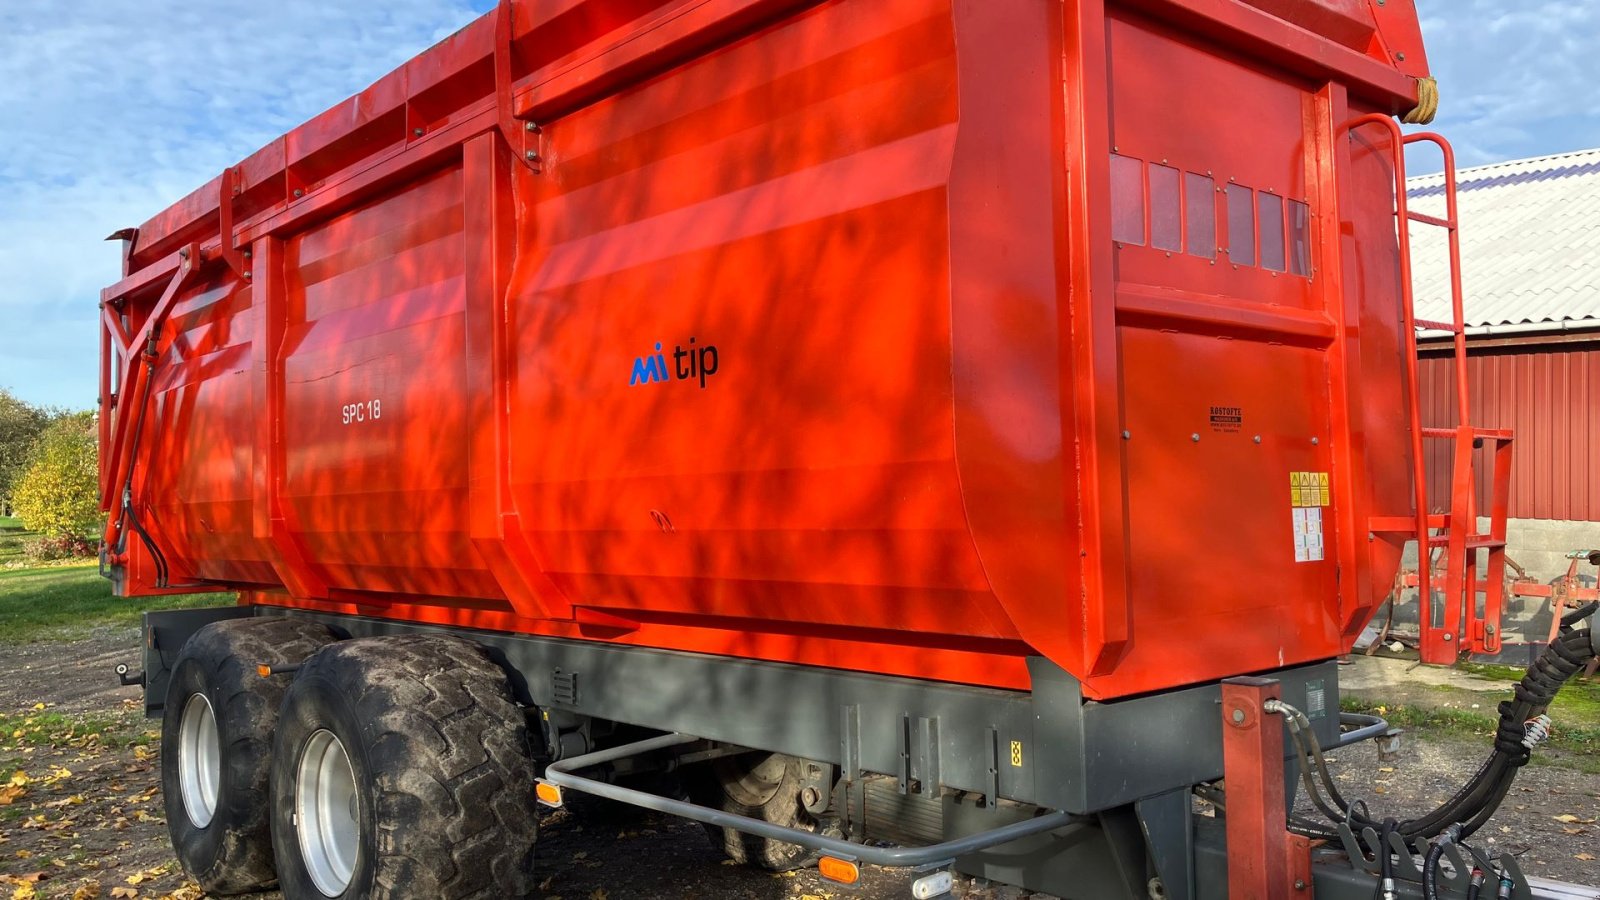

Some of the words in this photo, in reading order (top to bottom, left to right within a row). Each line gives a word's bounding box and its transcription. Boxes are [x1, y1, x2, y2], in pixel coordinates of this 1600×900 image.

[673, 337, 719, 389] tip
[342, 402, 364, 425] SPC
[367, 399, 381, 420] 18
